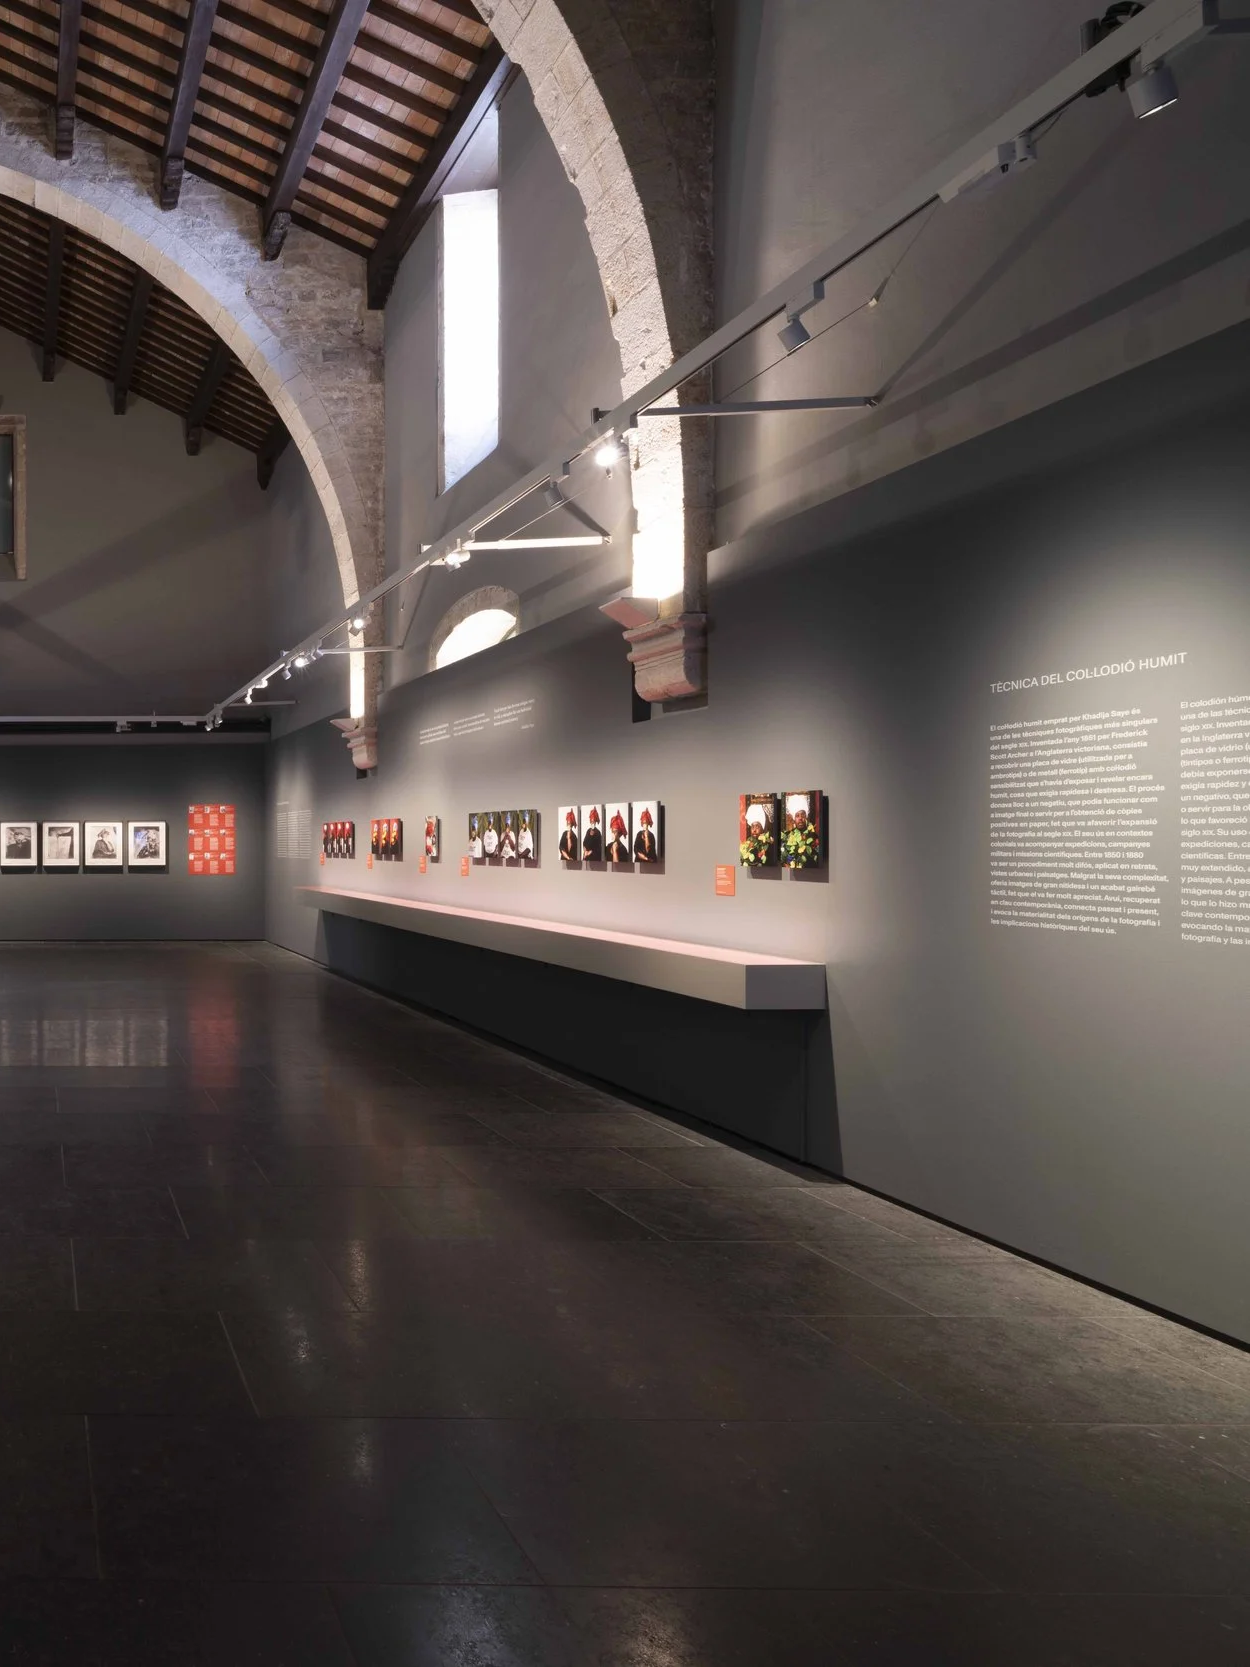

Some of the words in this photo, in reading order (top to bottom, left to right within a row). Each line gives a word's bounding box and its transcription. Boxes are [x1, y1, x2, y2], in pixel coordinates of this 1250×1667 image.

[990, 676, 1038, 693] TÈCNICA
[1041, 674, 1063, 686] DEL
[1139, 652, 1187, 670] HUMIT
[1190, 697, 1227, 708] colodión
[1180, 724, 1200, 732] siglo
[1202, 732, 1244, 742] Inglaterra
[1181, 748, 1204, 756] placa
[1218, 744, 1244, 752] vidrio
[1181, 759, 1214, 768] (tintipos
[1181, 782, 1205, 790] exigía
[1207, 780, 1239, 789] rapidez
[1193, 793, 1231, 802] negativo,
[1181, 841, 1240, 849] expediciones,
[1188, 876, 1224, 884] paisajes.
[1181, 887, 1223, 896] imágenes
[1182, 933, 1222, 943] fotografía
